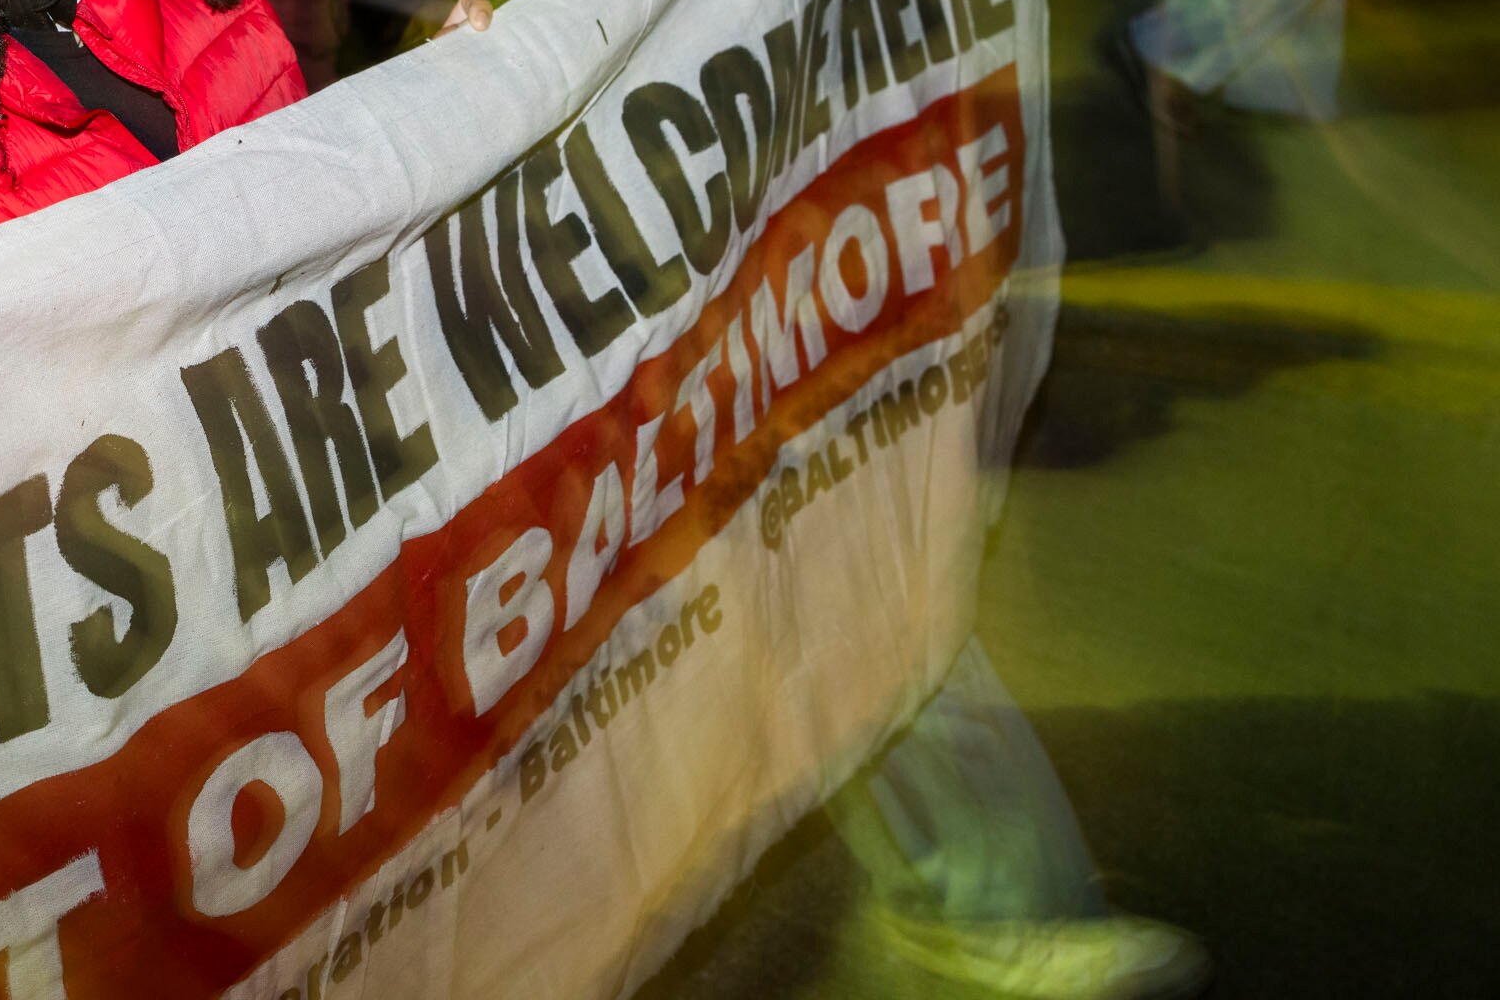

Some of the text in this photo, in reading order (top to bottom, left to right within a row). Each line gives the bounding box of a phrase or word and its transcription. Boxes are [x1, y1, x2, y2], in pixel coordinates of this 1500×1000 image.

[180, 257, 439, 626] ARE
[187, 624, 410, 918] OF
[463, 124, 1011, 719] BALTIMORE
[278, 838, 469, 1000] ration
[519, 583, 723, 805] Baltimore
